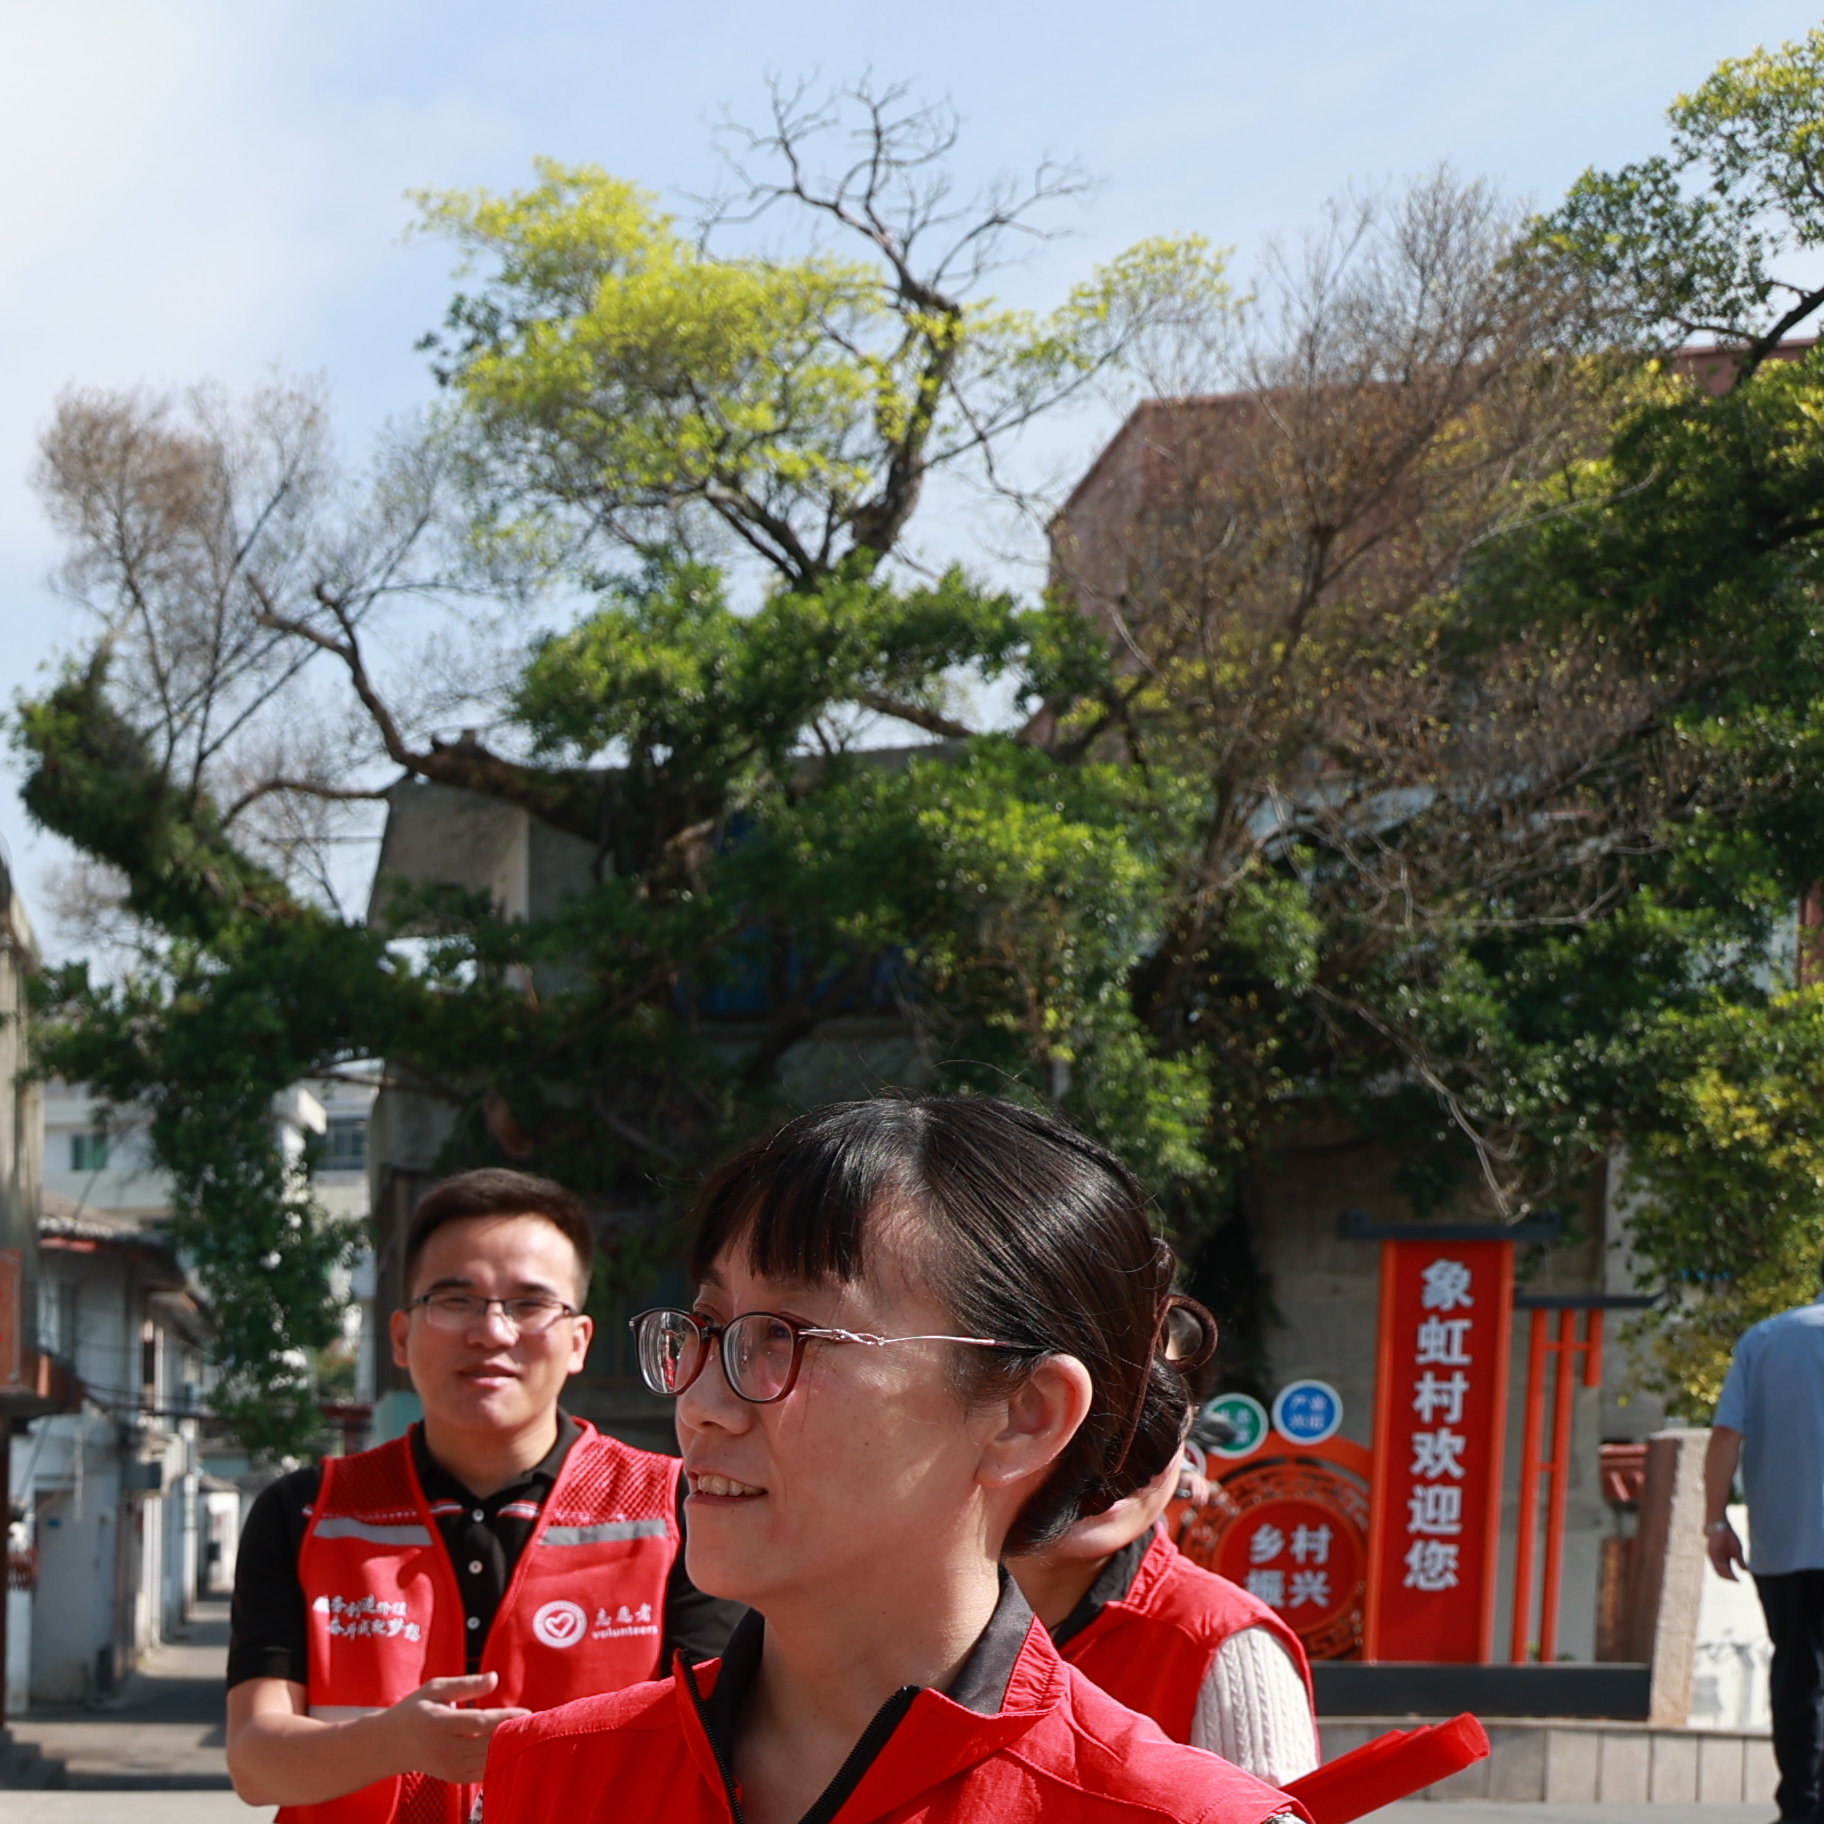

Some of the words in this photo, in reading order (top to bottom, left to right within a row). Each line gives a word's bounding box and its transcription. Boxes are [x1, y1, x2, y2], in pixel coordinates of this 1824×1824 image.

[1403, 1257, 1476, 1593] 象虹村欢迎您
[1249, 1523, 1334, 1565] 乡村
[1244, 1568, 1331, 1609] 振兴
